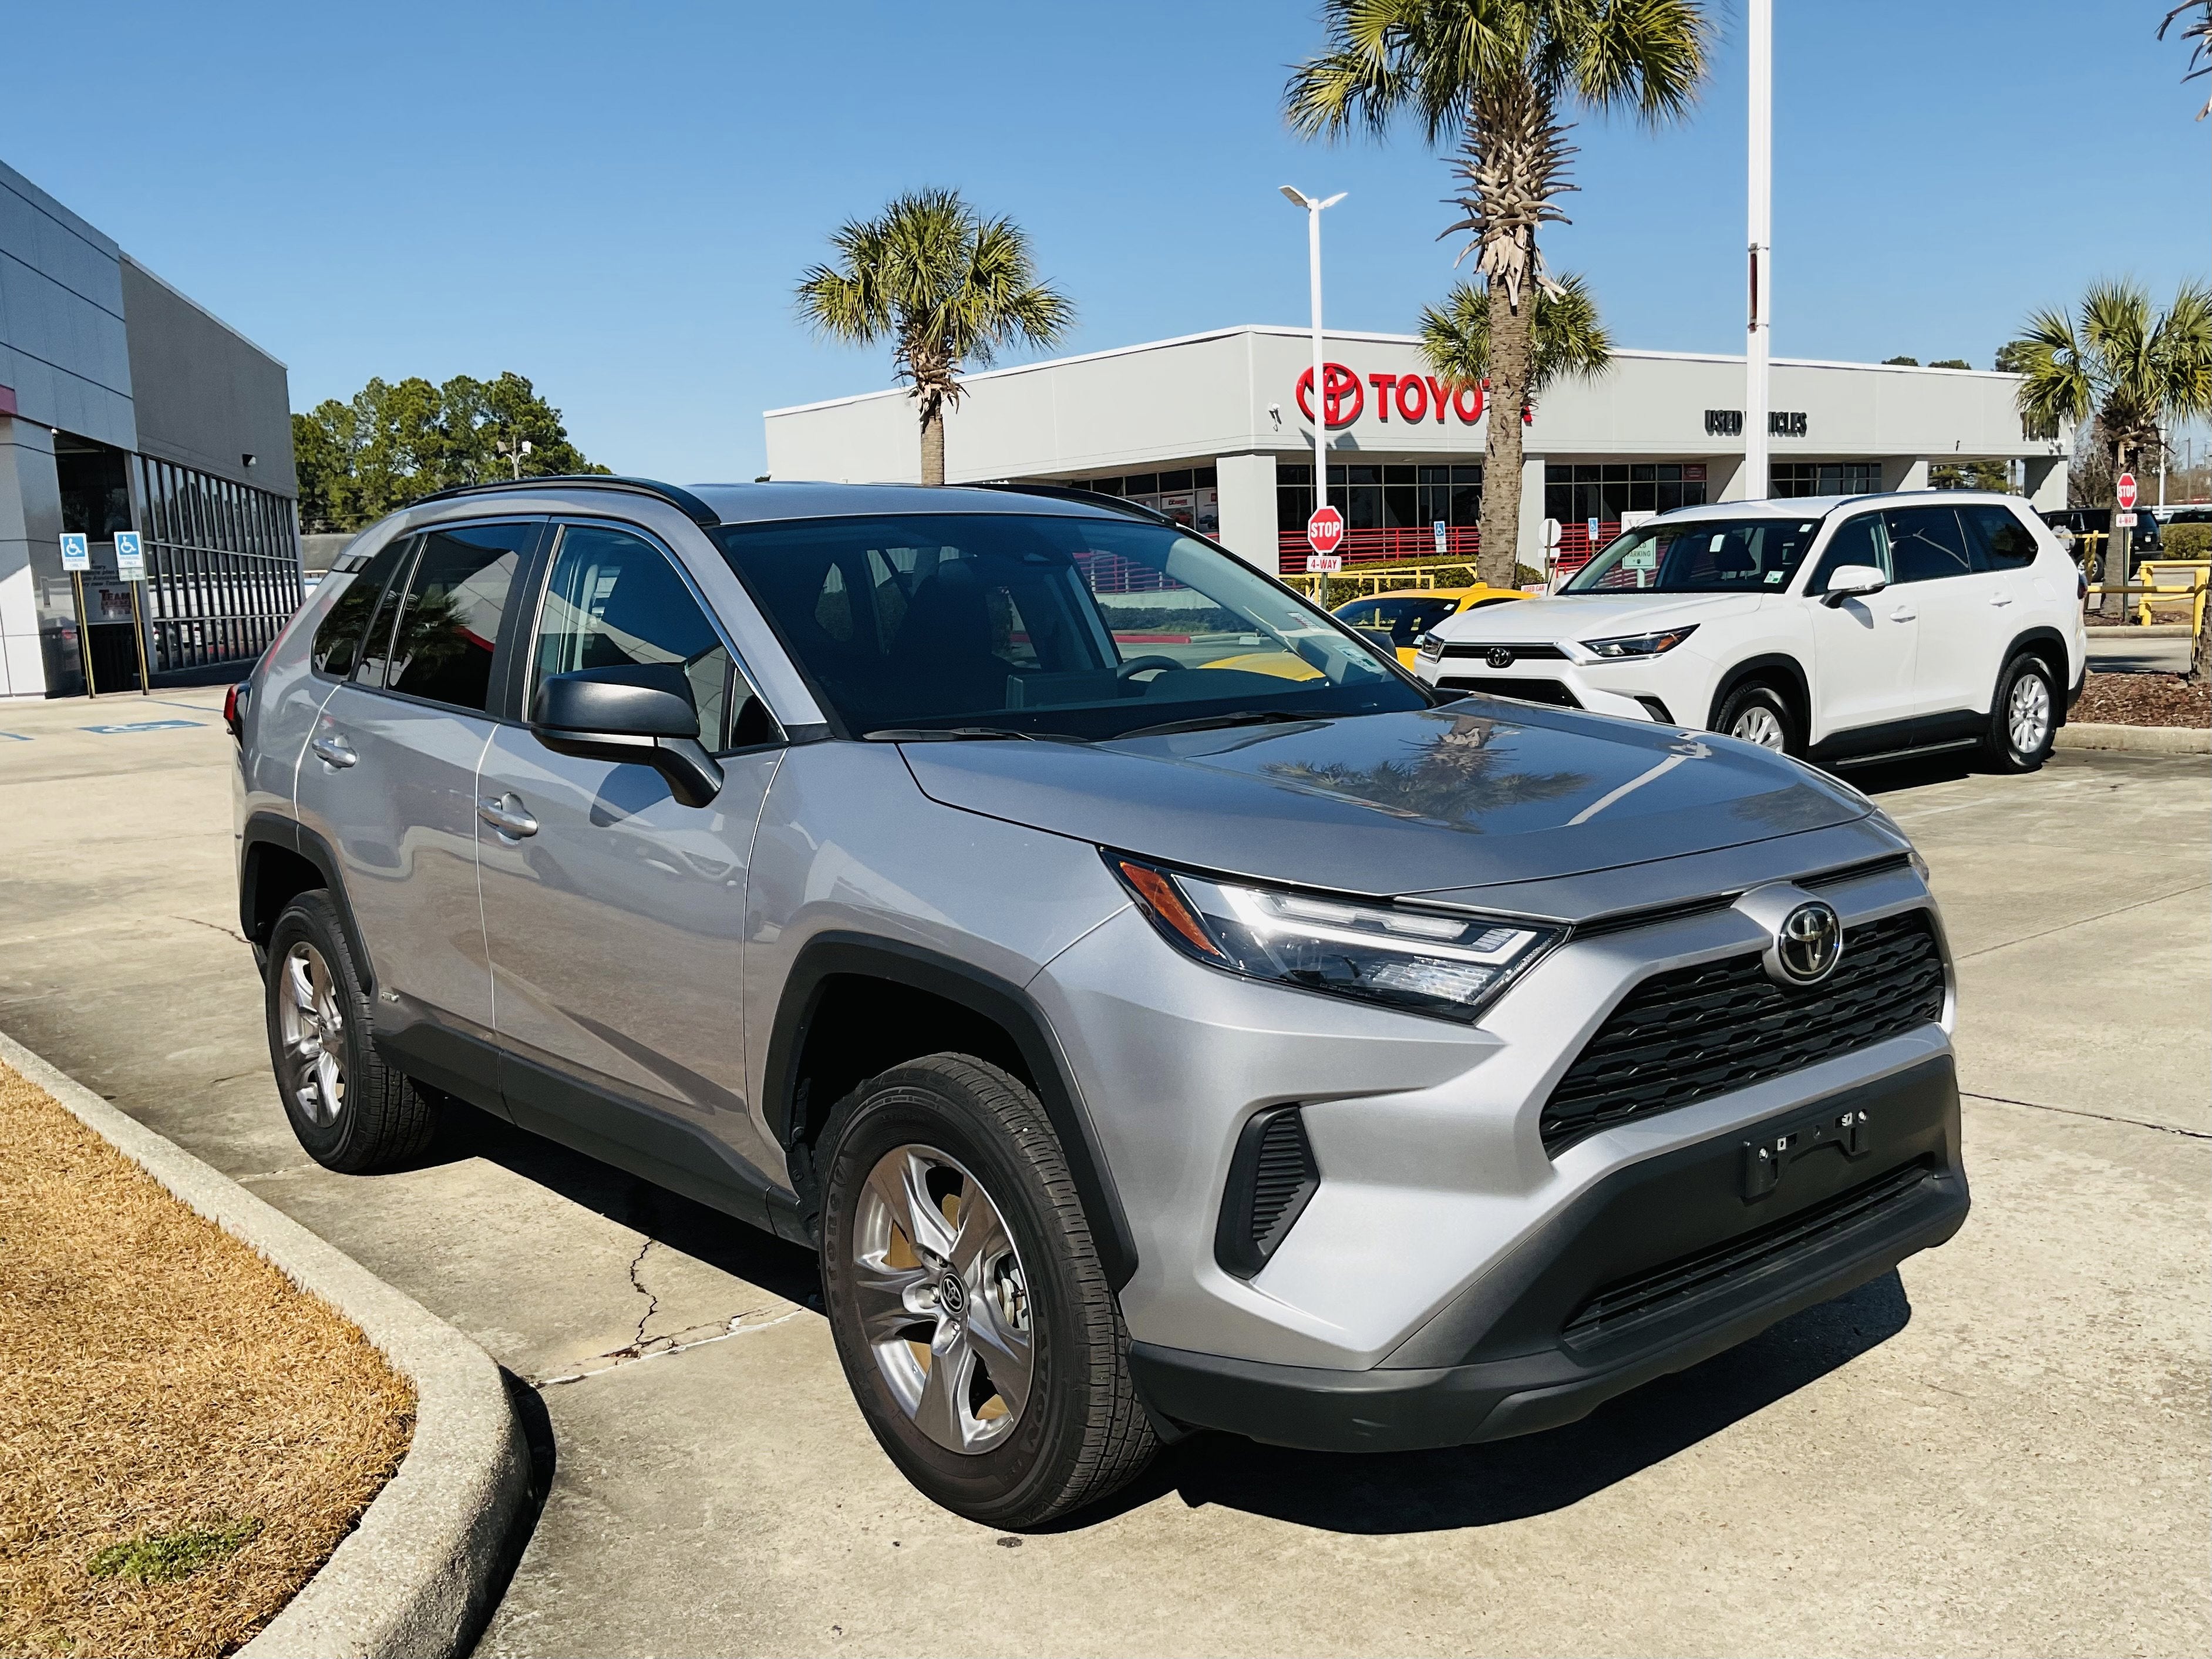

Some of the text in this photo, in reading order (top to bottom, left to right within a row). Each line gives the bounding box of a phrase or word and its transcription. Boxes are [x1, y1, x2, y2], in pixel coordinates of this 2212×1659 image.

[1369, 373, 1533, 426] TOYO
[1705, 410, 1742, 435] USED
[2119, 485, 2134, 497] STOP
[1311, 521, 1340, 538] STOP
[1311, 559, 1337, 569] 4-WAY
